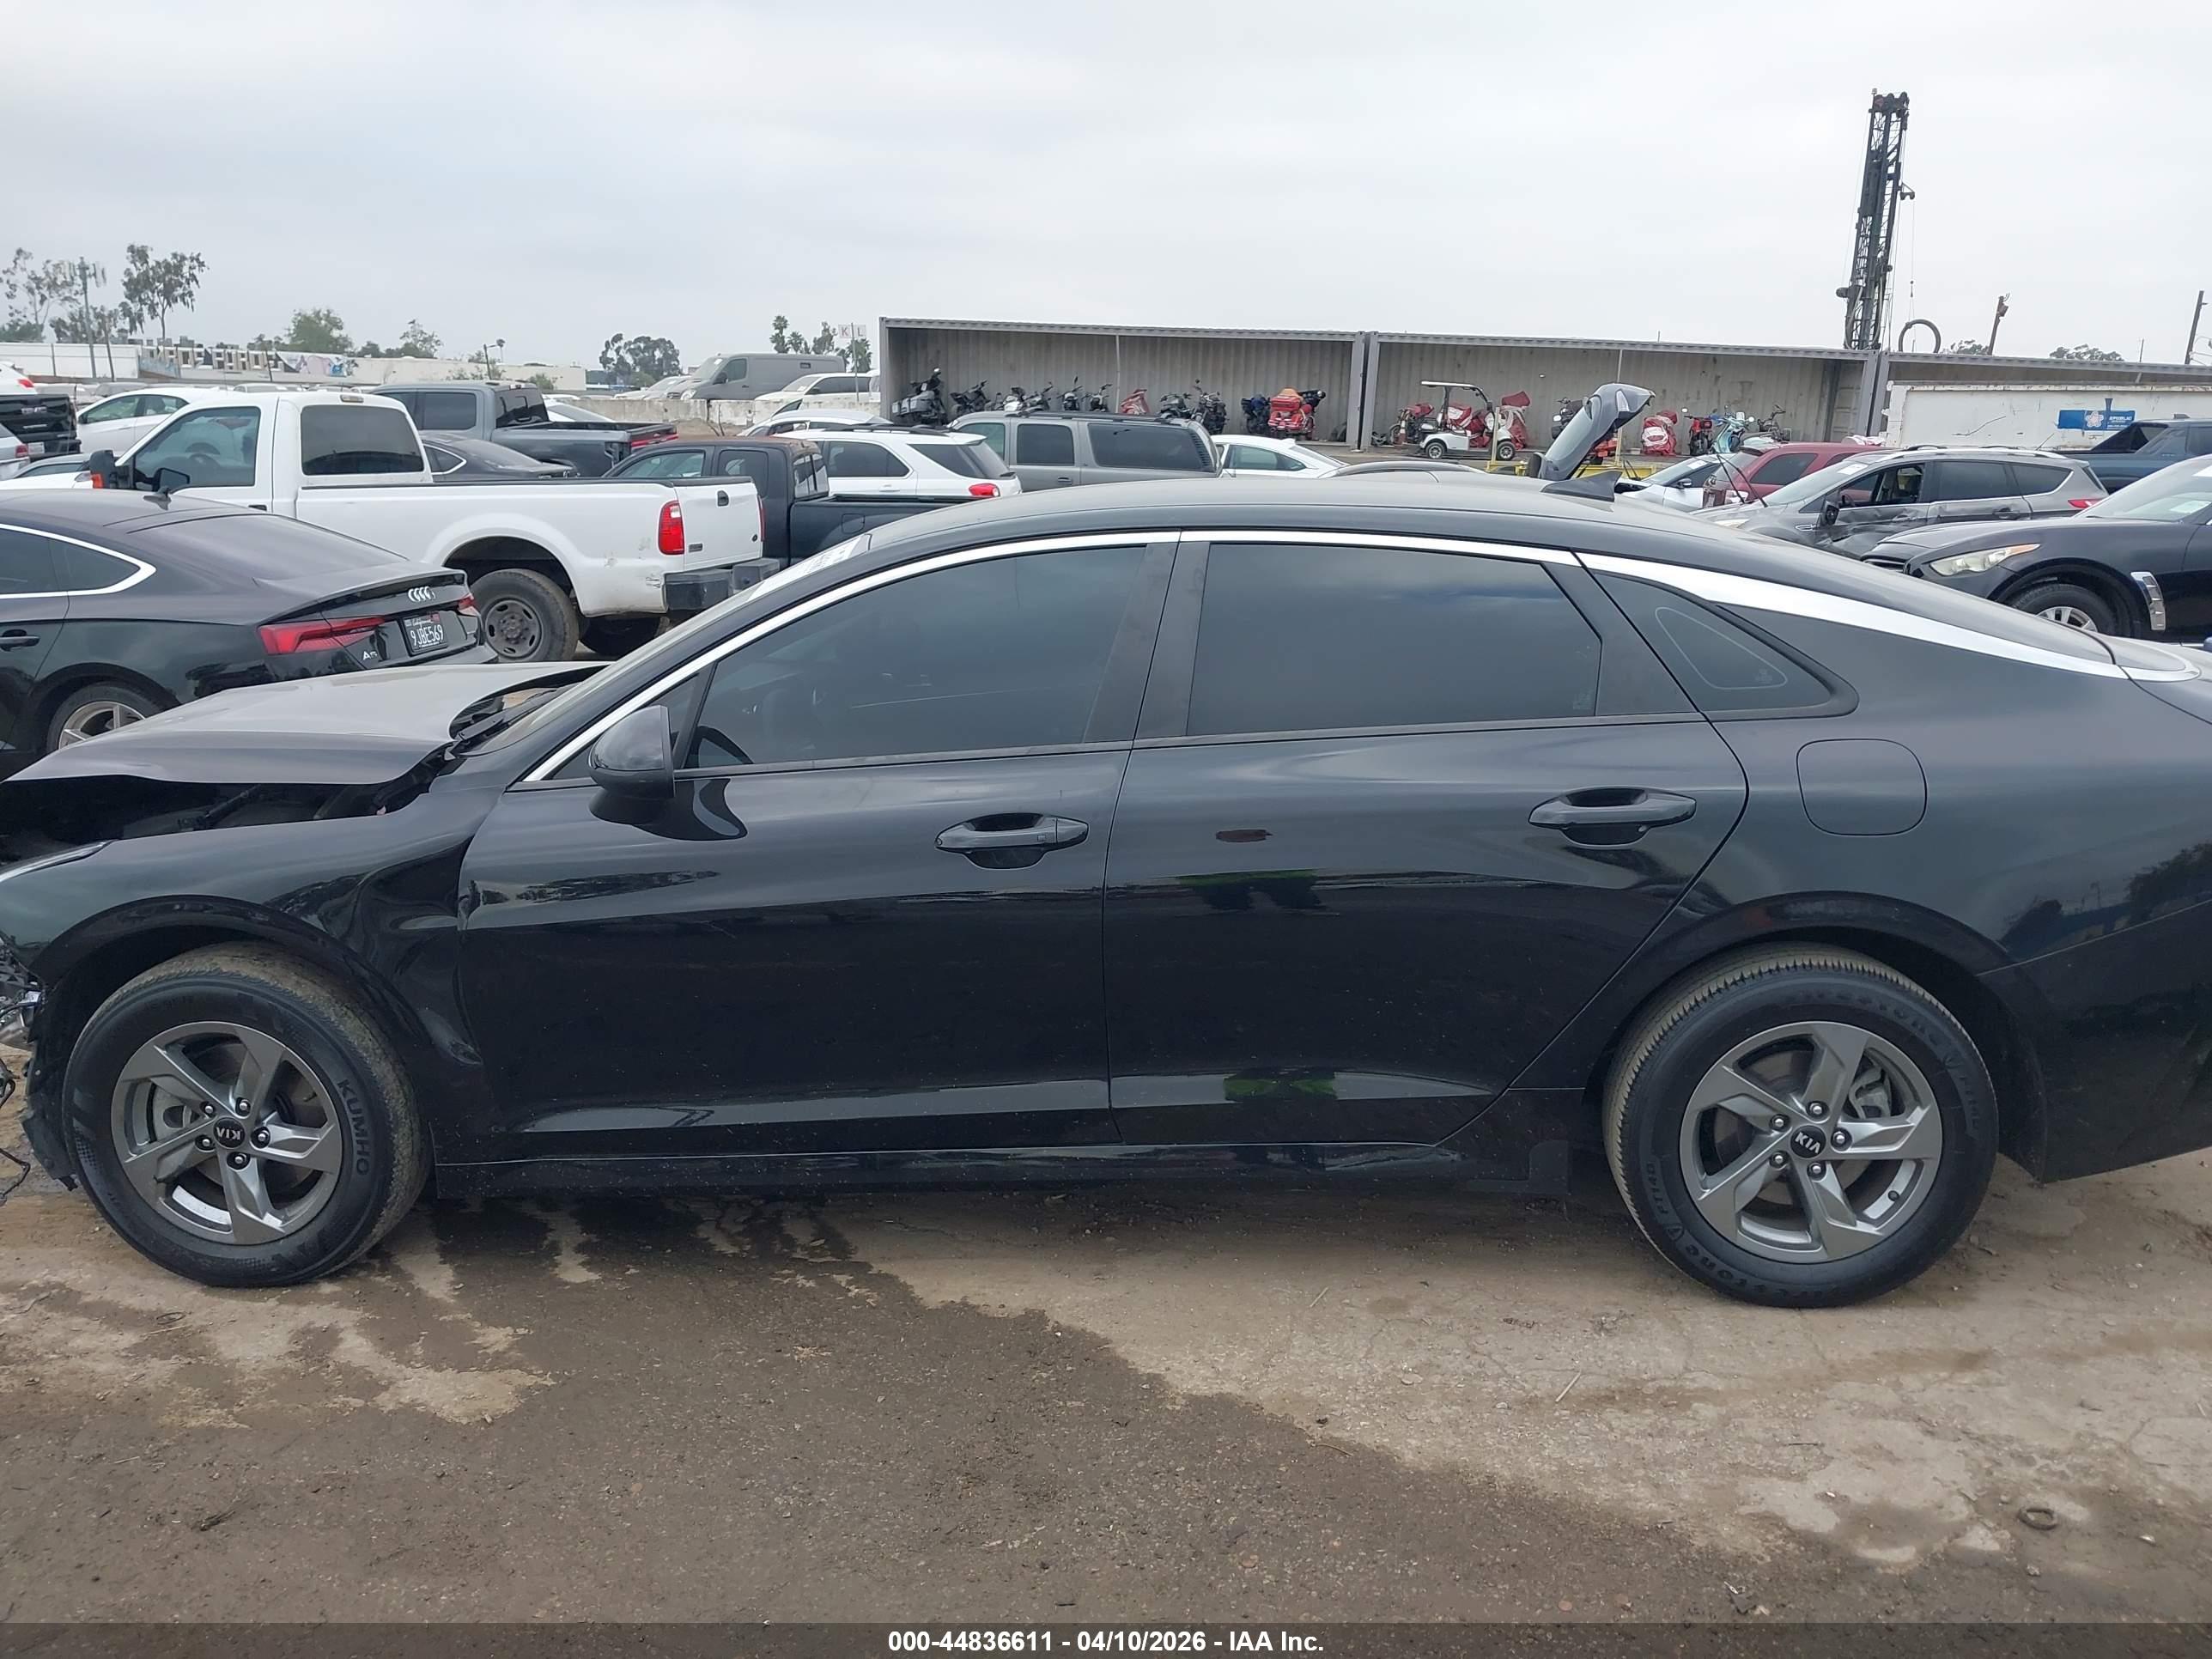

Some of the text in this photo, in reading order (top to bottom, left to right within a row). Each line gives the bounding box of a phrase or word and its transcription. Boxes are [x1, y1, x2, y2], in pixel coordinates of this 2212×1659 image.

[842, 326, 848, 336] K
[857, 326, 864, 337] L
[410, 624, 444, 647] 9JBE569
[216, 1127, 241, 1140] KIA
[337, 1079, 370, 1176] KUMHO
[1795, 1131, 1821, 1155] KIA
